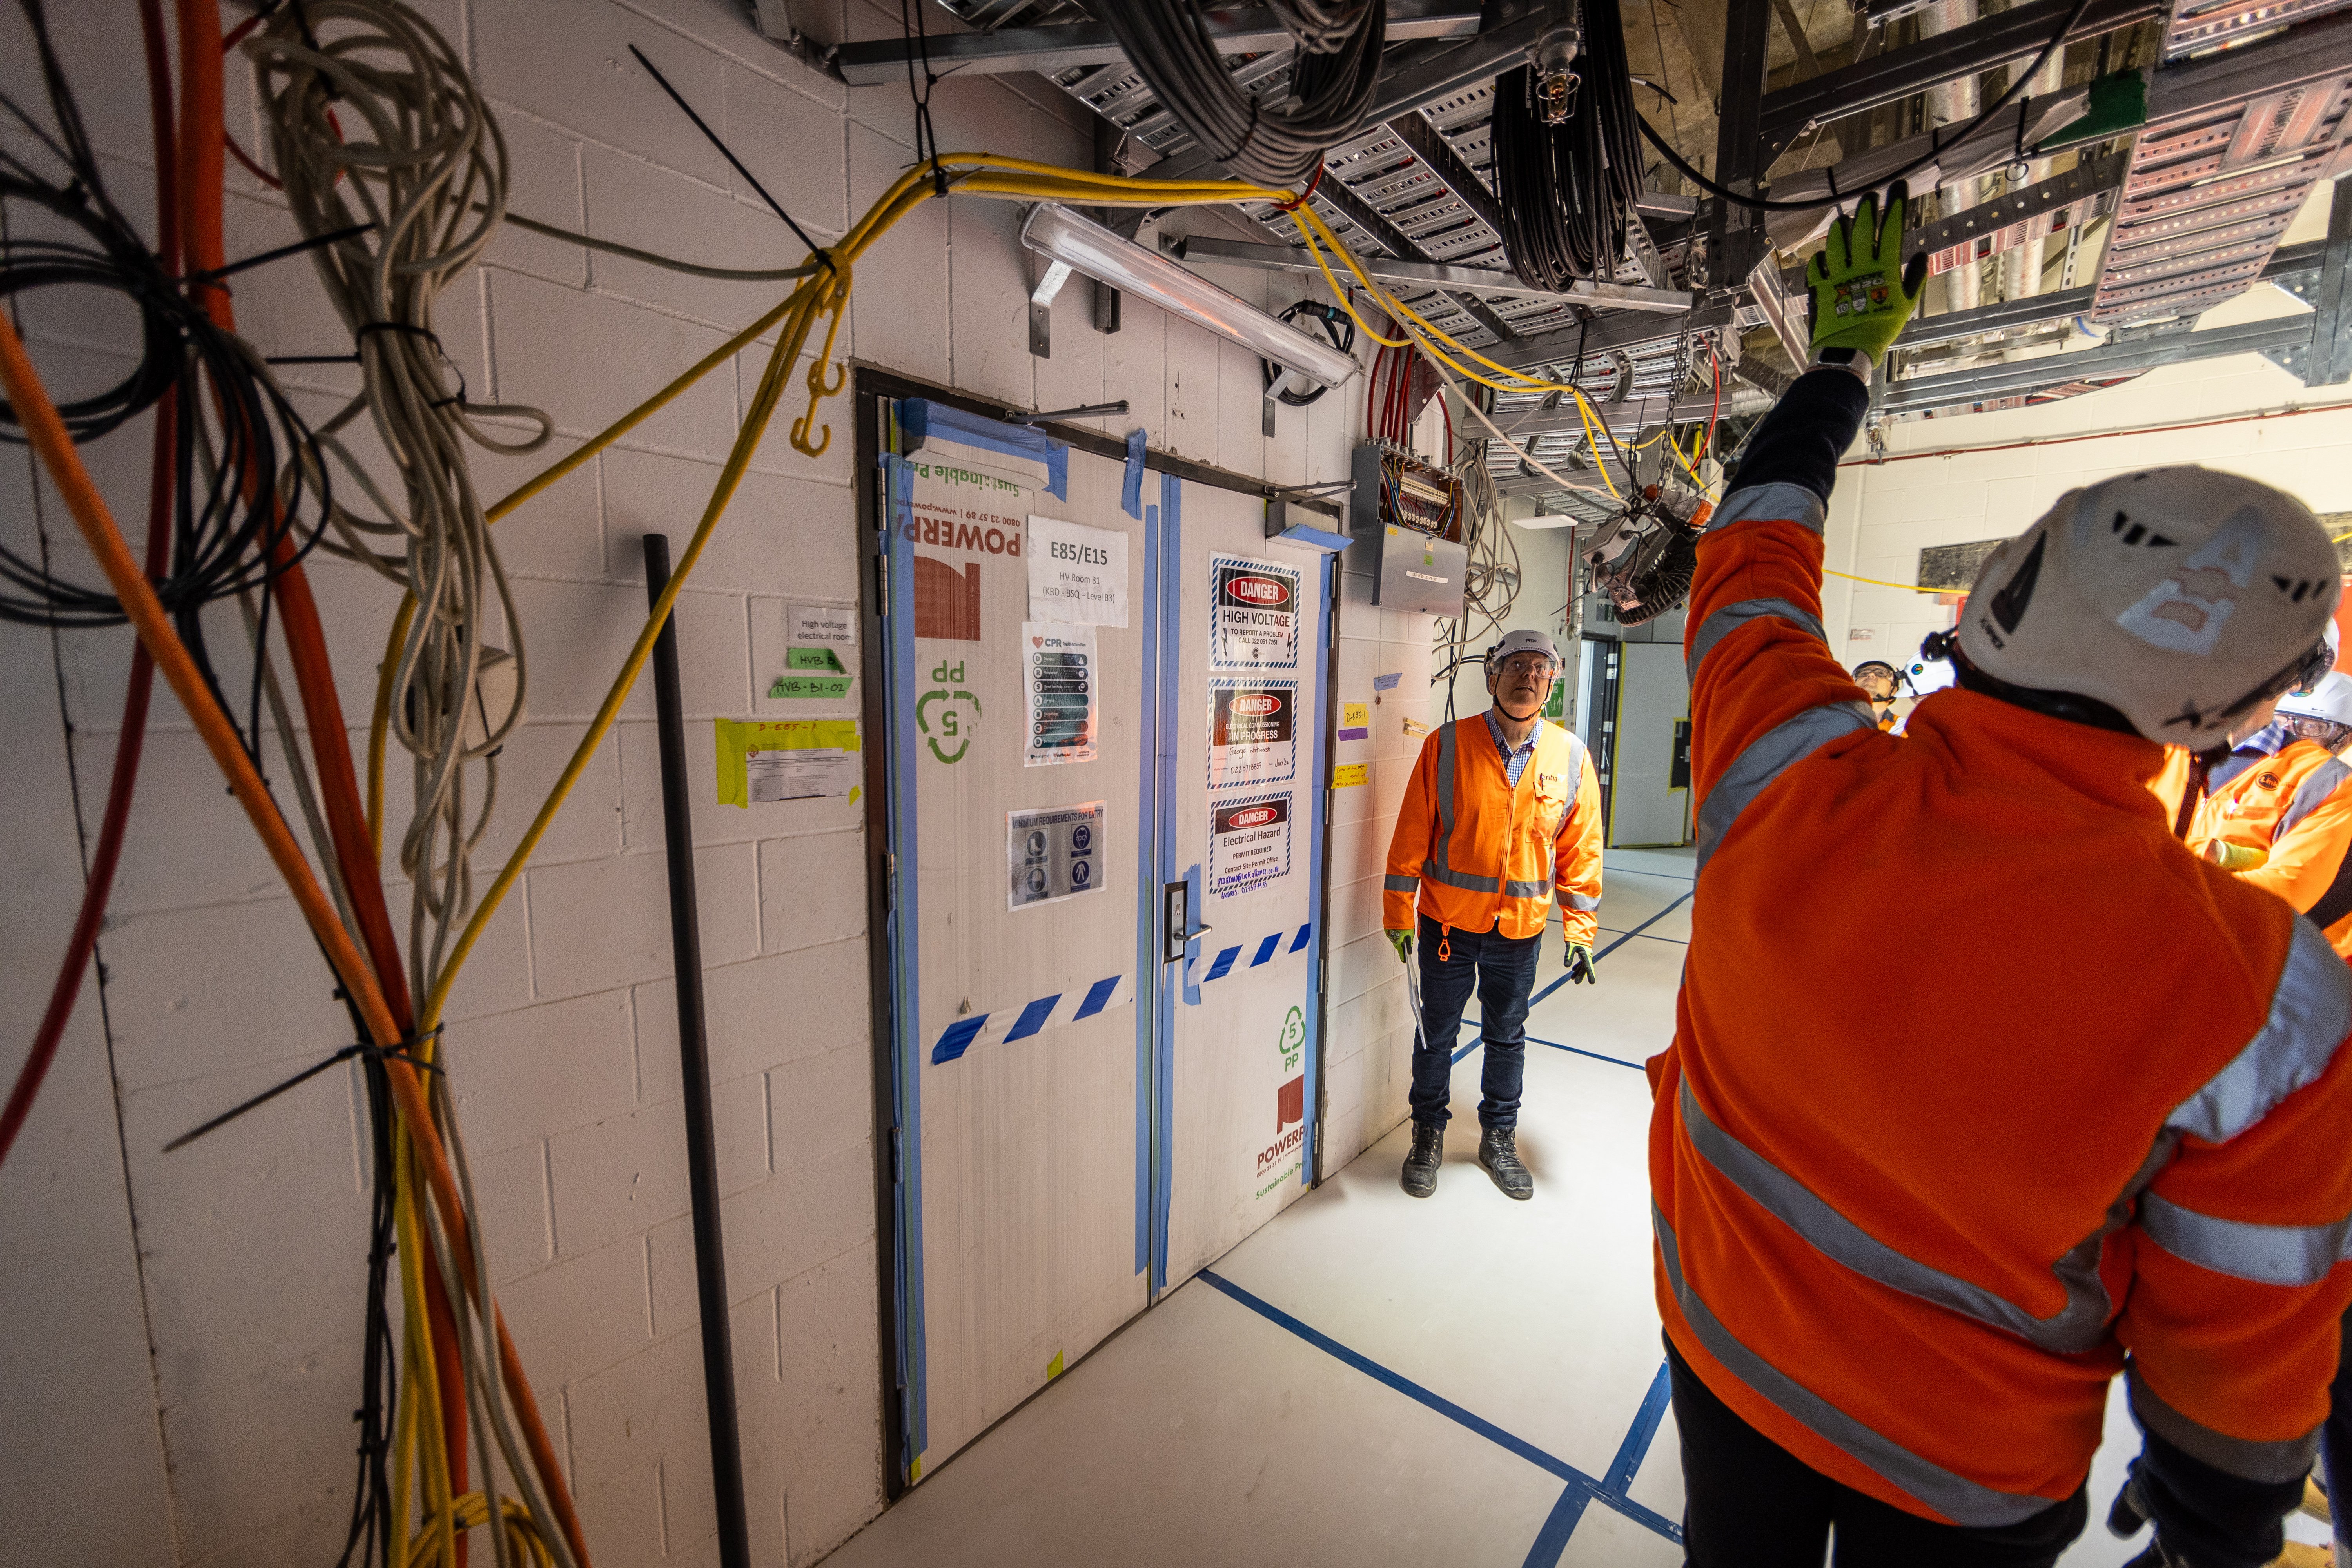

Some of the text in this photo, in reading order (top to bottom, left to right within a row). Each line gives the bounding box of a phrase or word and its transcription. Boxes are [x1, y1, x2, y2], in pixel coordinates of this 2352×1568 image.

[965, 511, 976, 519] 89
[991, 515, 1000, 523] 23
[1003, 517, 1020, 527] 0800
[1051, 541, 1108, 566] E85/E15
[1059, 572, 1100, 585] HV Room B1
[1042, 586, 1060, 597] (KRD
[1066, 590, 1080, 600] BSQ
[1087, 592, 1103, 602] Level
[1104, 593, 1115, 604] B3)
[1241, 581, 1278, 600] DANGER
[802, 620, 847, 630] High voltage
[1223, 610, 1290, 627] HIGH VOLTAGE
[797, 632, 831, 640] electrical
[1045, 638, 1062, 647] CPR
[932, 660, 964, 683] PP
[1240, 699, 1272, 711] DANGER
[942, 711, 958, 736] 5
[1232, 730, 1278, 741] IN PROGRESS
[1229, 747, 1246, 759] George
[1039, 812, 1077, 826] REQUIREMENTS
[1078, 811, 1088, 820] FOR
[1089, 809, 1103, 819] ENTRY
[1239, 810, 1268, 825] DANGER
[1223, 827, 1280, 847] Electrical Hazard
[1233, 846, 1272, 859] PERMIT REQUIRED
[1225, 865, 1241, 873] Contact
[1252, 859, 1265, 868] Permit
[1289, 1022, 1296, 1040] 5
[1285, 1053, 1299, 1072] PP
[1257, 1168, 1266, 1178] 0800
[1256, 1167, 1294, 1200] Sustainable
